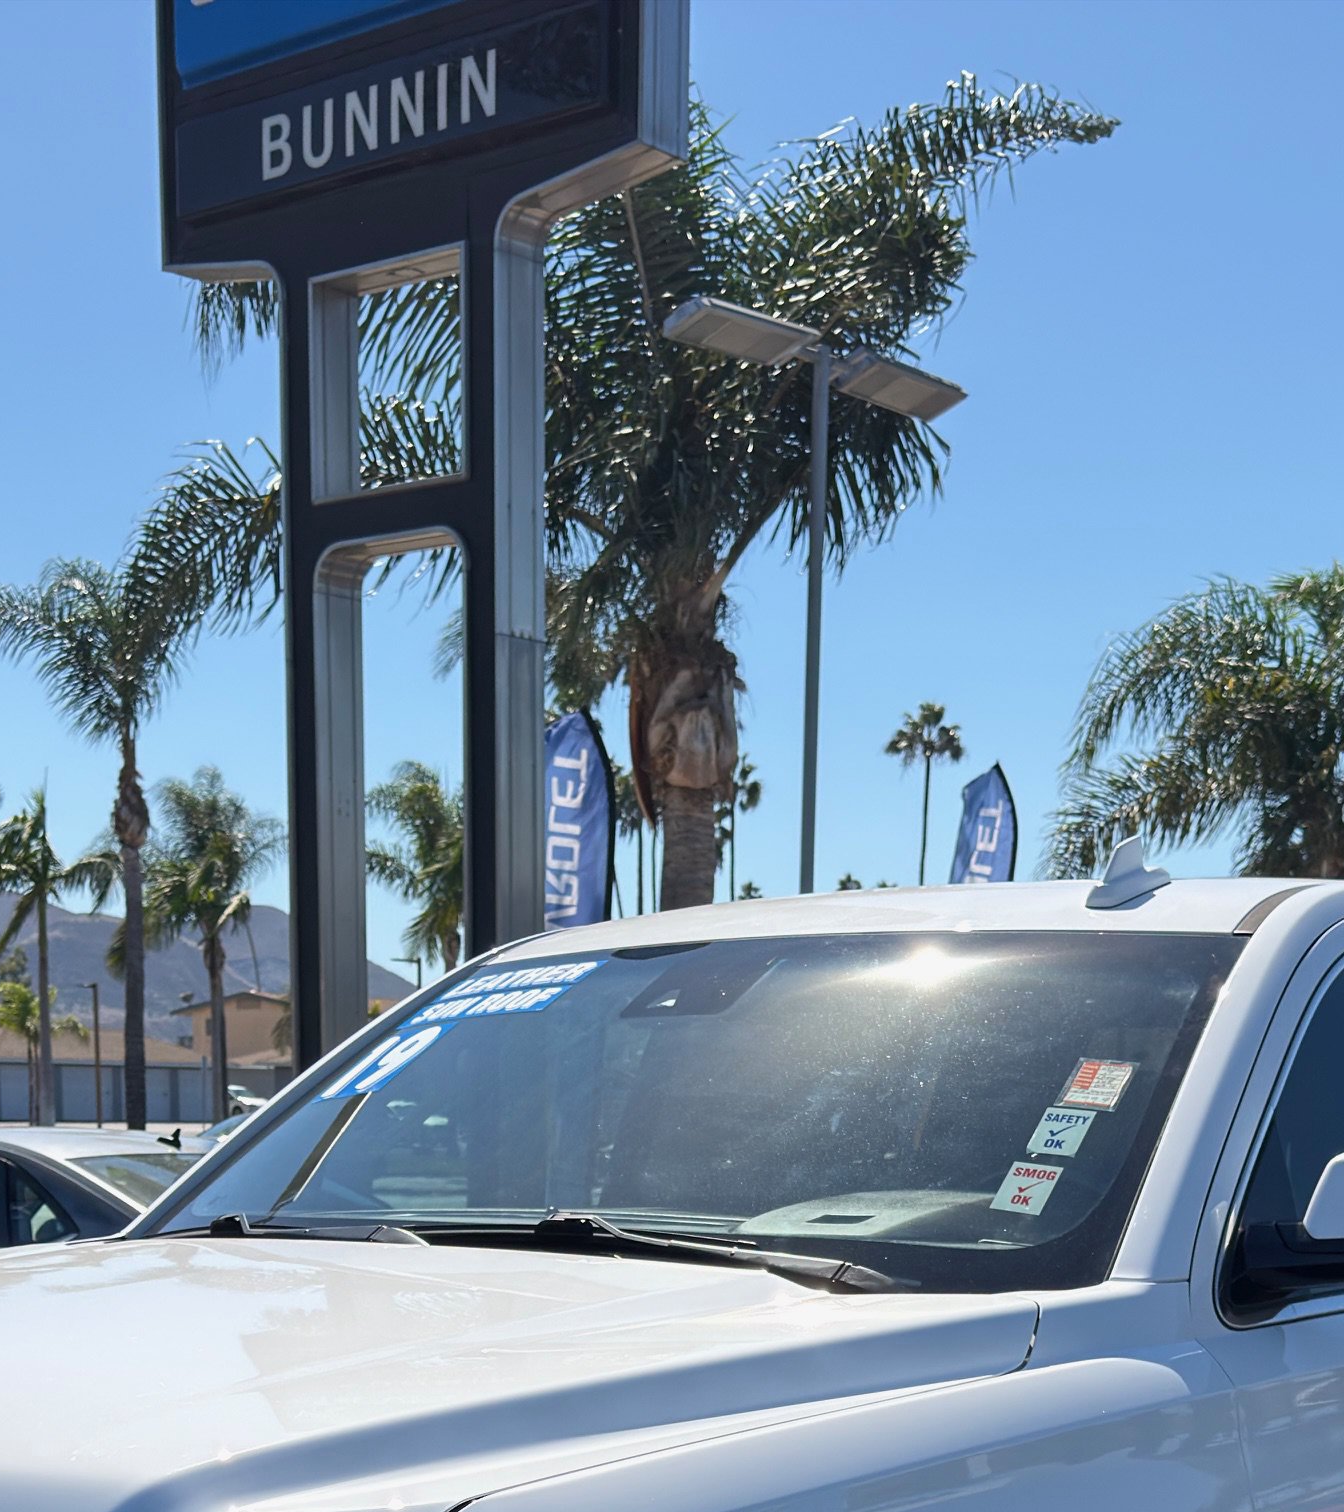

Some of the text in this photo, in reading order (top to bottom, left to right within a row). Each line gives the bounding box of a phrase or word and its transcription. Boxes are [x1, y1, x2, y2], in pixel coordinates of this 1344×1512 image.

[261, 48, 497, 181] BUNNIN
[441, 961, 598, 1000] LEATHER
[410, 987, 563, 1025] SUN ROOF
[320, 1026, 442, 1099] 19
[1044, 1112, 1091, 1125] SAFETY
[1043, 1138, 1066, 1150] OK
[1012, 1167, 1058, 1181] SMOG
[1010, 1194, 1033, 1206] OK
